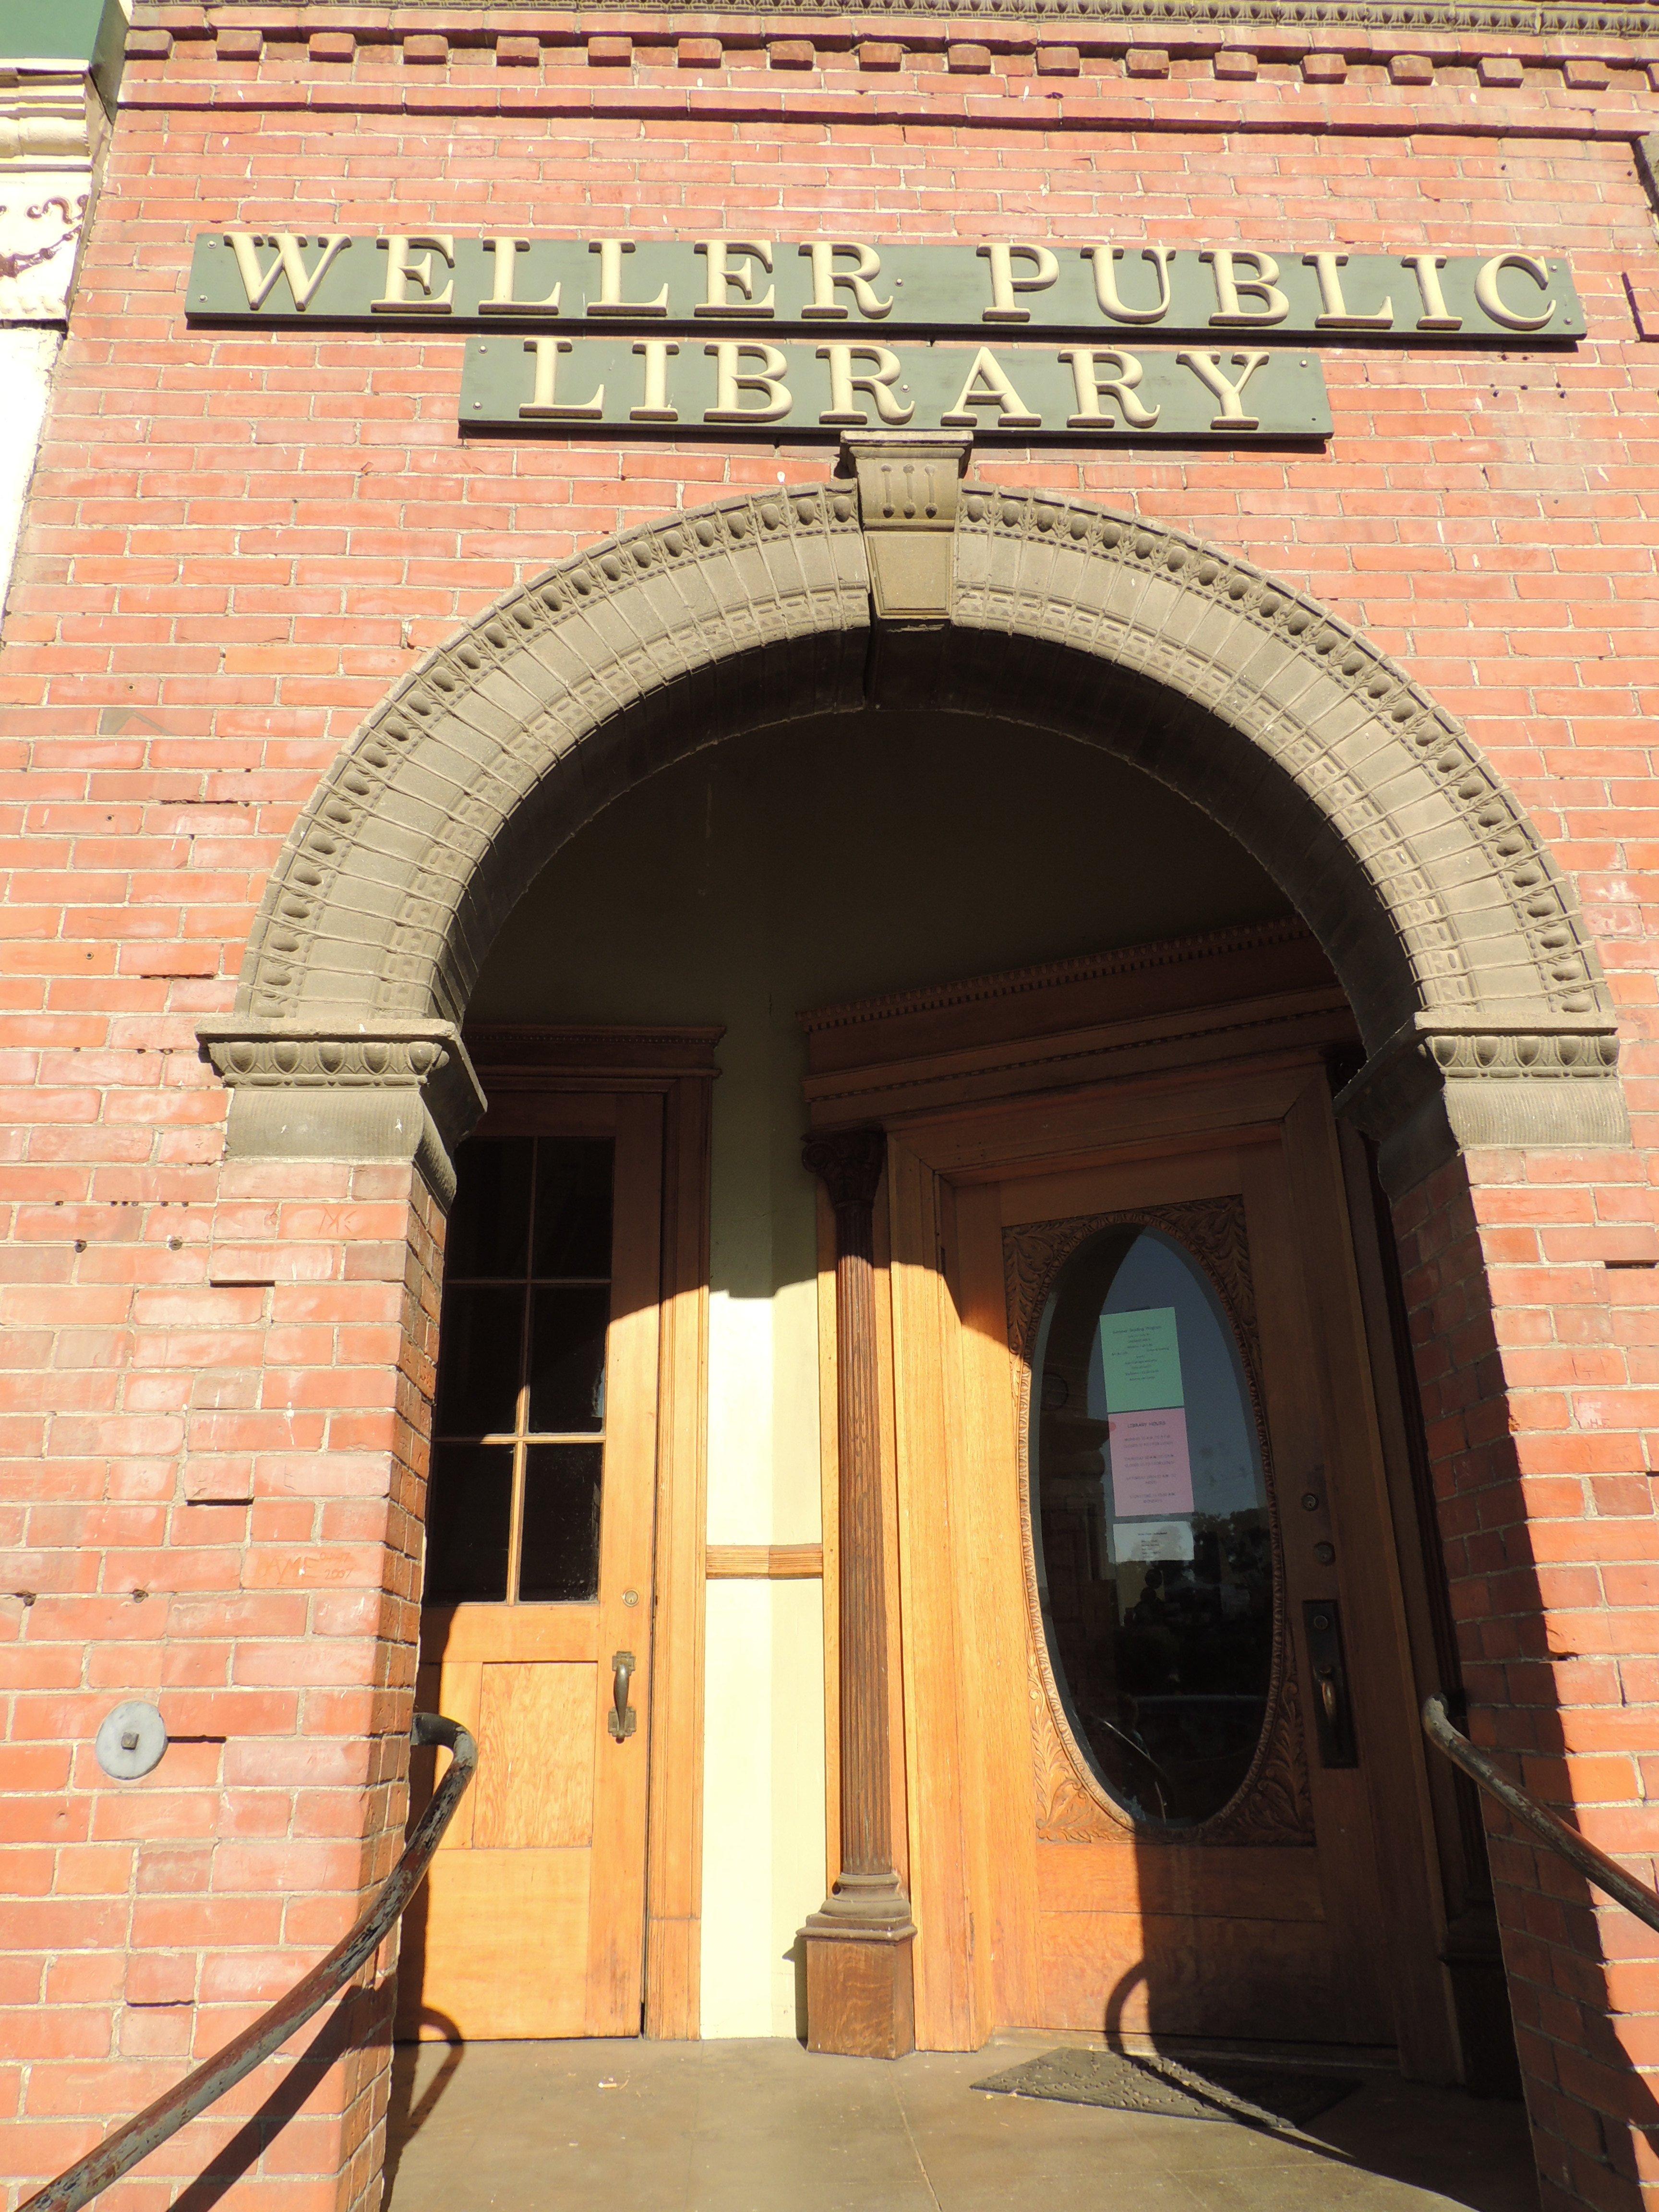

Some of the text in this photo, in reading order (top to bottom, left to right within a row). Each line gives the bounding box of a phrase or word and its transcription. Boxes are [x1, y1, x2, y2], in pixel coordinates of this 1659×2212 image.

[223, 232, 1557, 331] WELLER PUBLIC
[518, 337, 1270, 429] LIBRARY
